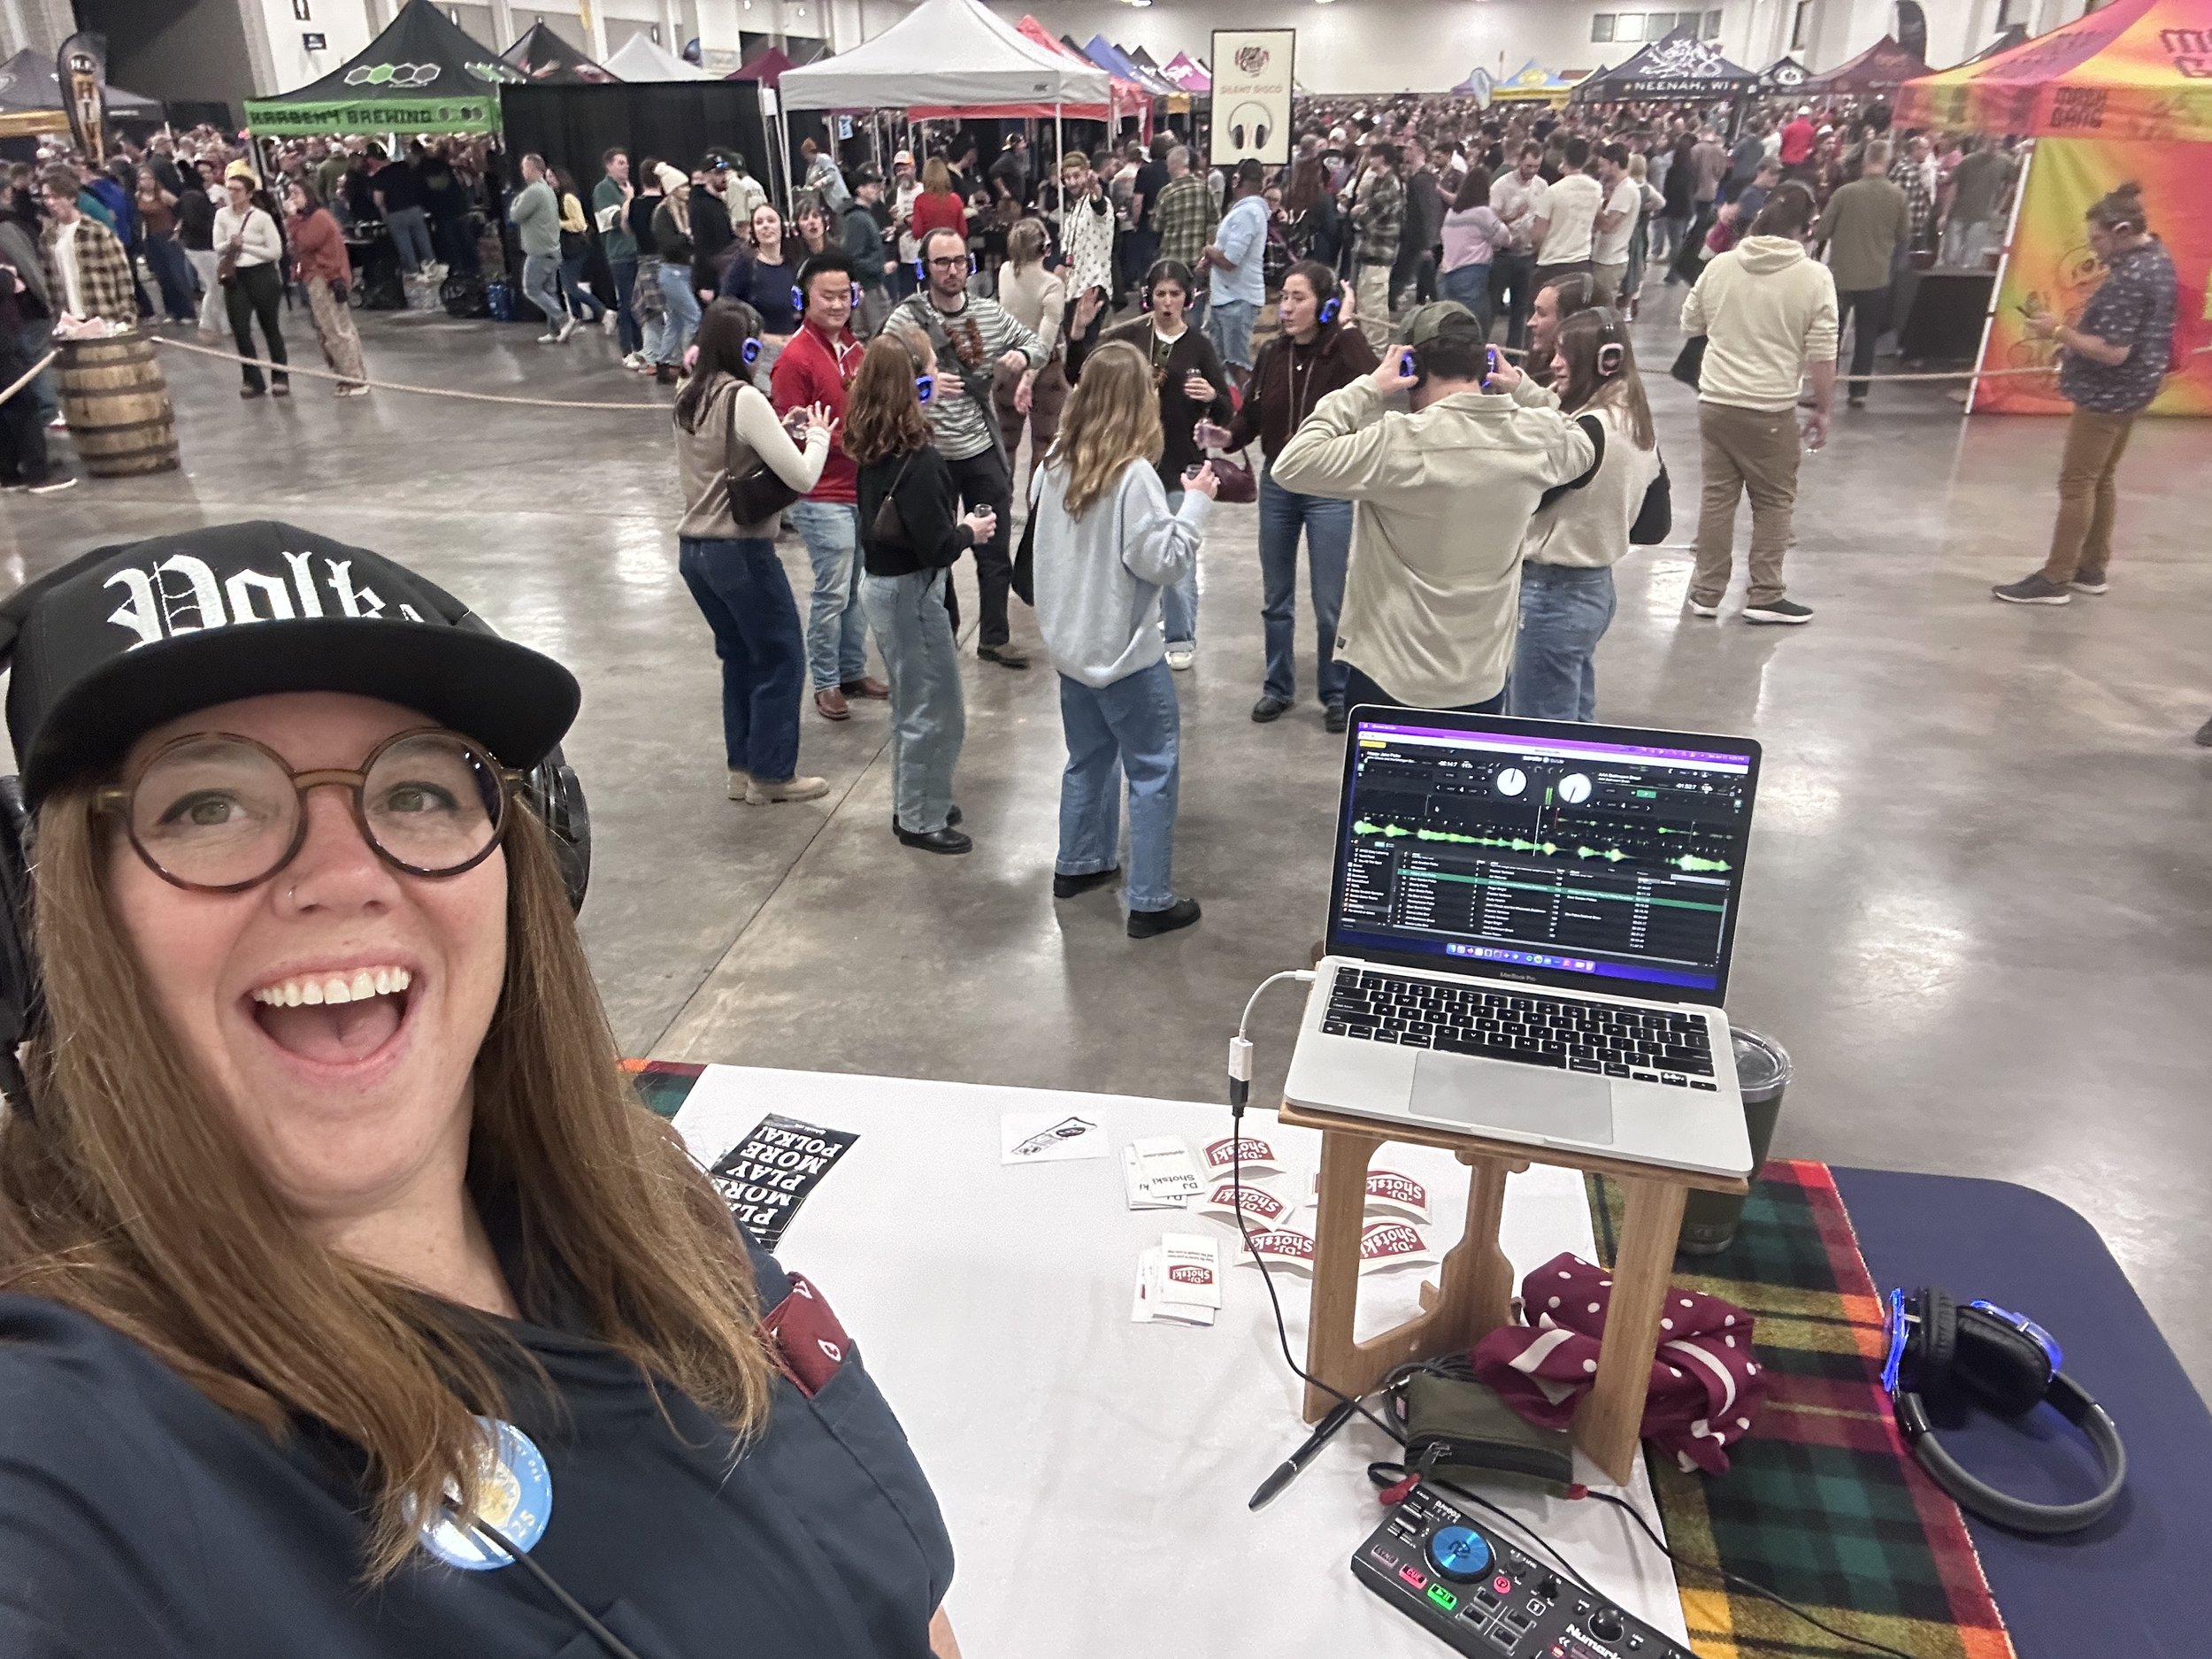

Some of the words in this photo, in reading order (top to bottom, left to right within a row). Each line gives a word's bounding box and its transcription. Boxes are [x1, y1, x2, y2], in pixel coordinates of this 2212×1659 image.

[1634, 81, 1705, 91] NEENAH,
[1712, 81, 1728, 90] WI
[348, 107, 432, 124] BREWING
[1500, 971, 1525, 980] MacBook
[754, 1125, 842, 1158] POLKA!
[740, 1141, 828, 1175] MORE
[1212, 1141, 1268, 1164] Shoski
[1243, 1151, 1259, 1160] DJ
[726, 1160, 807, 1191] PLAY
[1152, 1174, 1195, 1185] Shotski
[1367, 1179, 1422, 1200] Shotsk
[1392, 1190, 1409, 1202] DJ
[1360, 1227, 1417, 1258] Shotski
[1392, 1241, 1410, 1253] DJ
[1278, 1245, 1296, 1256] DJ
[1172, 1270, 1210, 1280] Shotski
[1407, 1567, 1422, 1581] CUE
[1565, 1624, 1623, 1659] Numark
